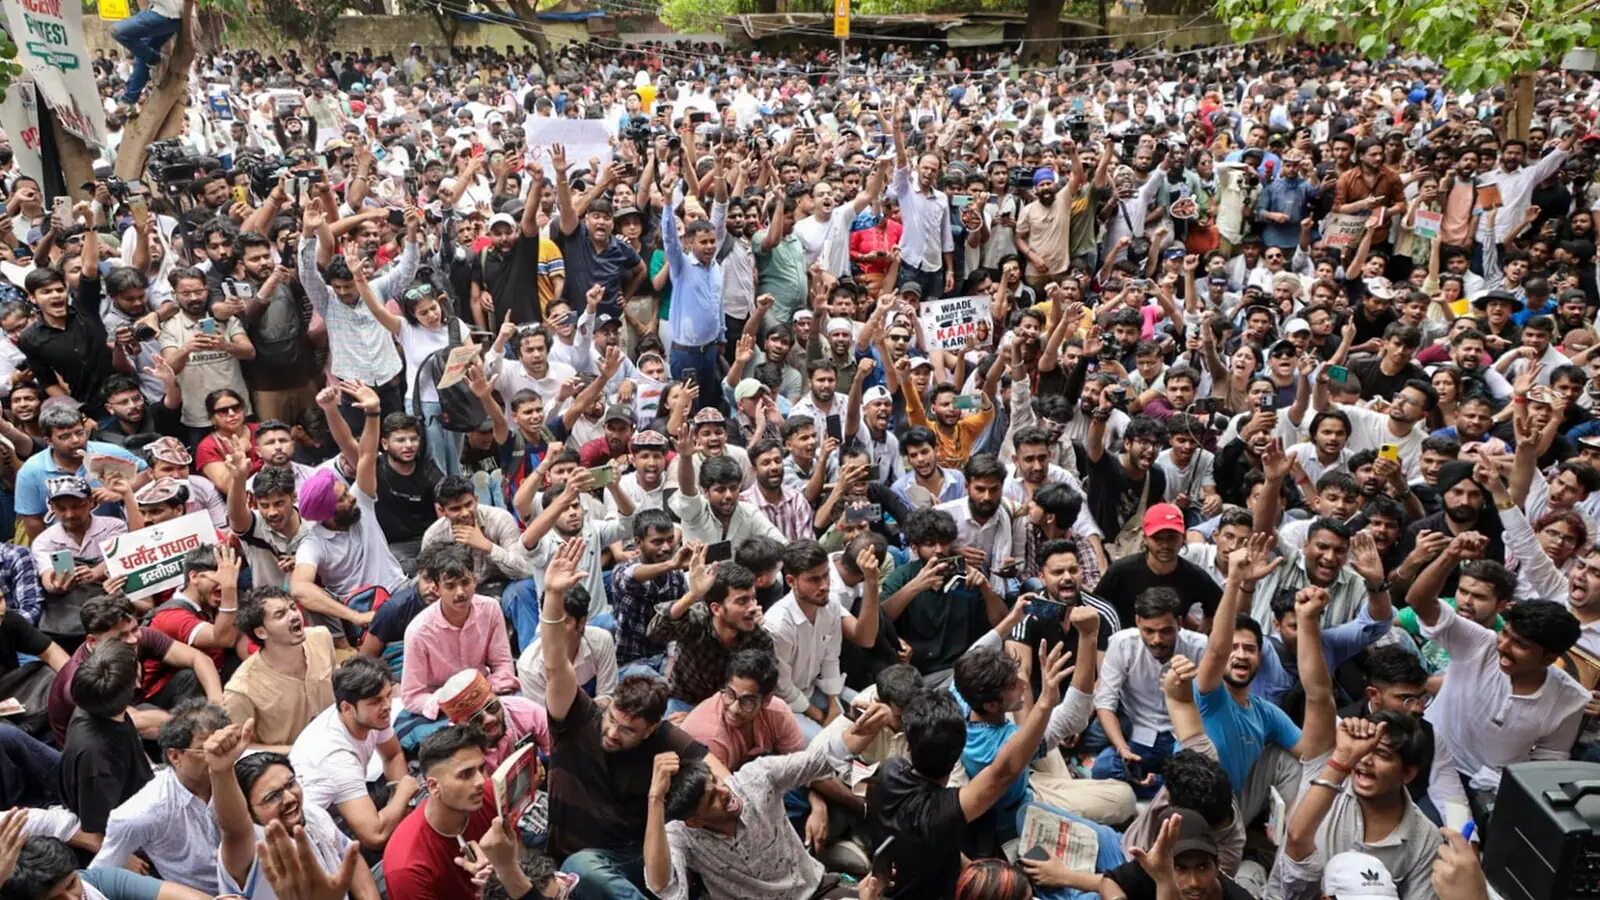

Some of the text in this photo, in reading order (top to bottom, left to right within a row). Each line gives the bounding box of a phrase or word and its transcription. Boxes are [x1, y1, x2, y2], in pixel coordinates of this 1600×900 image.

[941, 300, 972, 313] WAADE
[936, 312, 958, 322] BAHOT
[937, 323, 974, 340] KAAM
[158, 534, 200, 558] प्रधान
